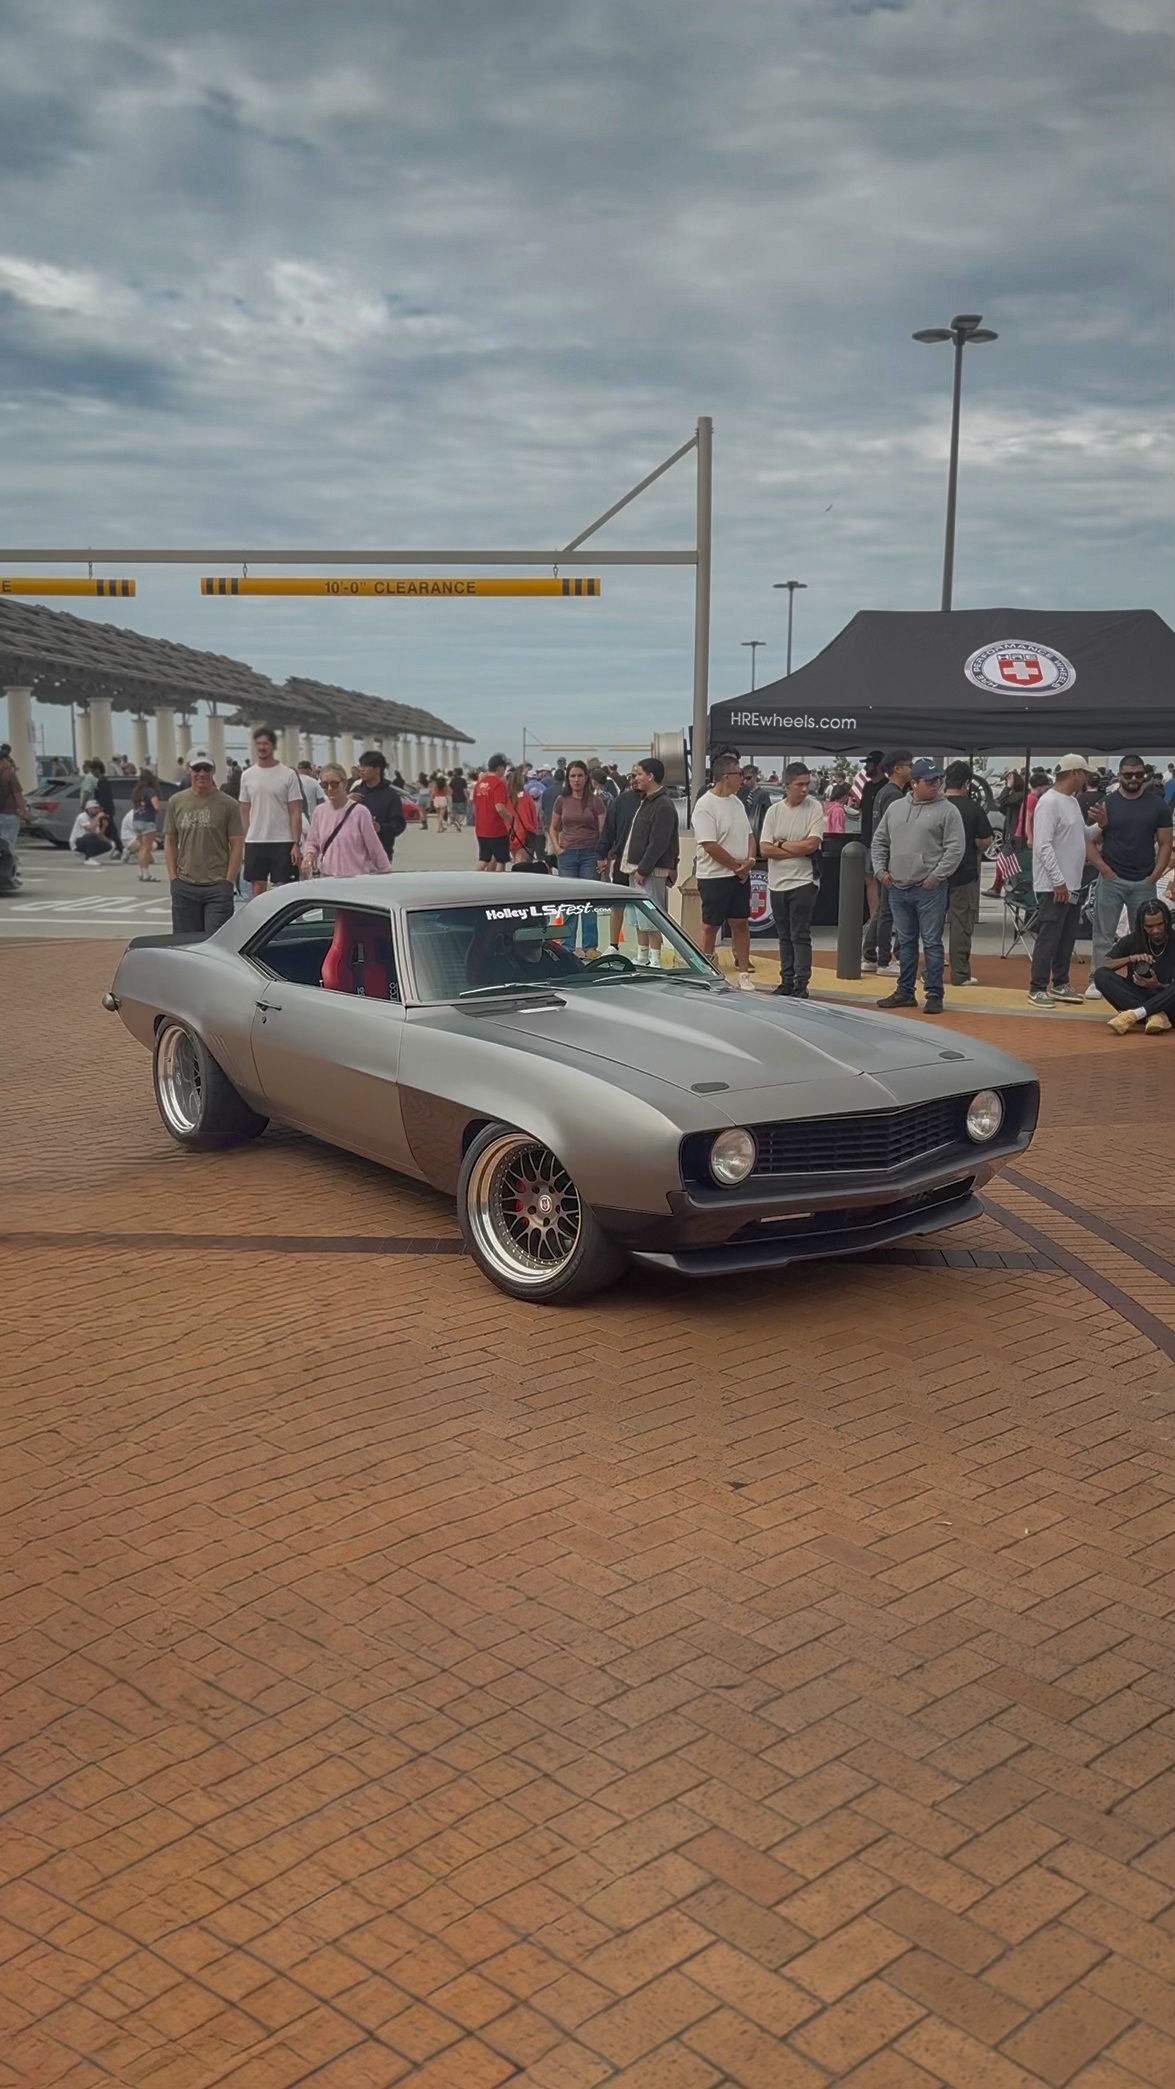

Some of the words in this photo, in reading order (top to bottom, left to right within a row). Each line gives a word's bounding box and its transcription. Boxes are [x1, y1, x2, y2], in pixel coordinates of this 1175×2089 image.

[2, 580, 12, 592] E
[374, 581, 477, 594] CLEARANCE
[1051, 659, 1068, 689] WHEELS
[731, 711, 857, 730] HREwheels.com
[485, 908, 528, 921] Holley
